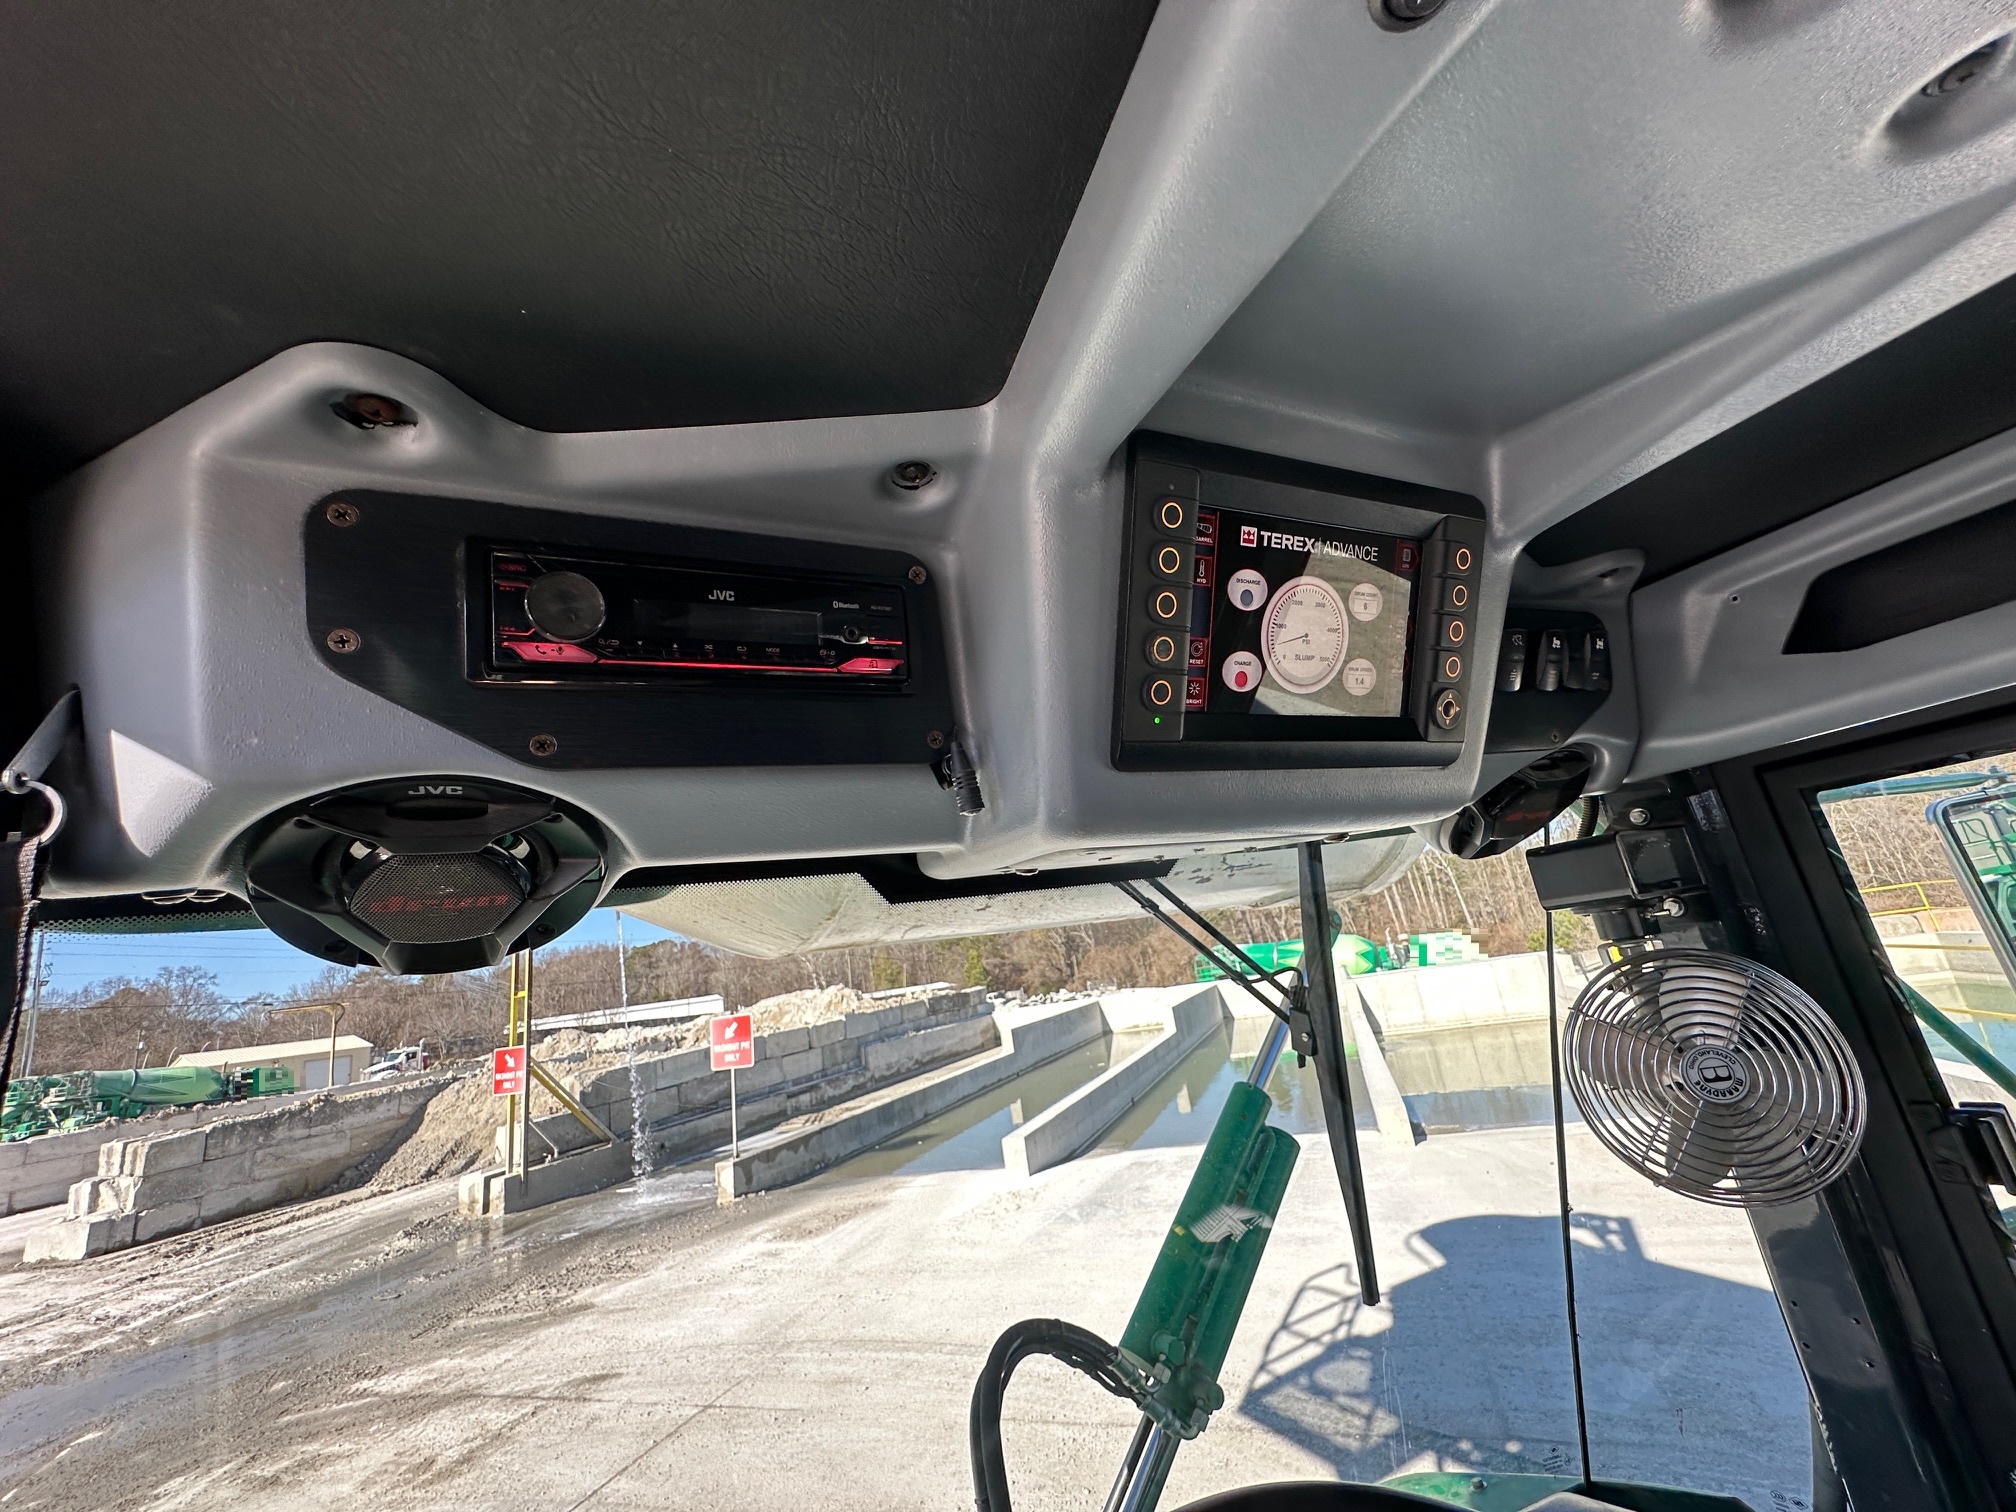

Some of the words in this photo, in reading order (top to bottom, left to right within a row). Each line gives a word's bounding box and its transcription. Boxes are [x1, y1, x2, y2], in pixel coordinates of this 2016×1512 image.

[1260, 530, 1316, 553] TEREX
[1323, 540, 1379, 562] ADVANCE
[708, 589, 735, 601] JVC
[838, 601, 860, 610] Bluetooth
[1363, 602, 1368, 611] 6
[1294, 653, 1315, 661] SLUMP
[1355, 677, 1364, 685] 1.4
[408, 785, 463, 795] JVC
[1694, 1077, 1744, 1098] MARADYNE
